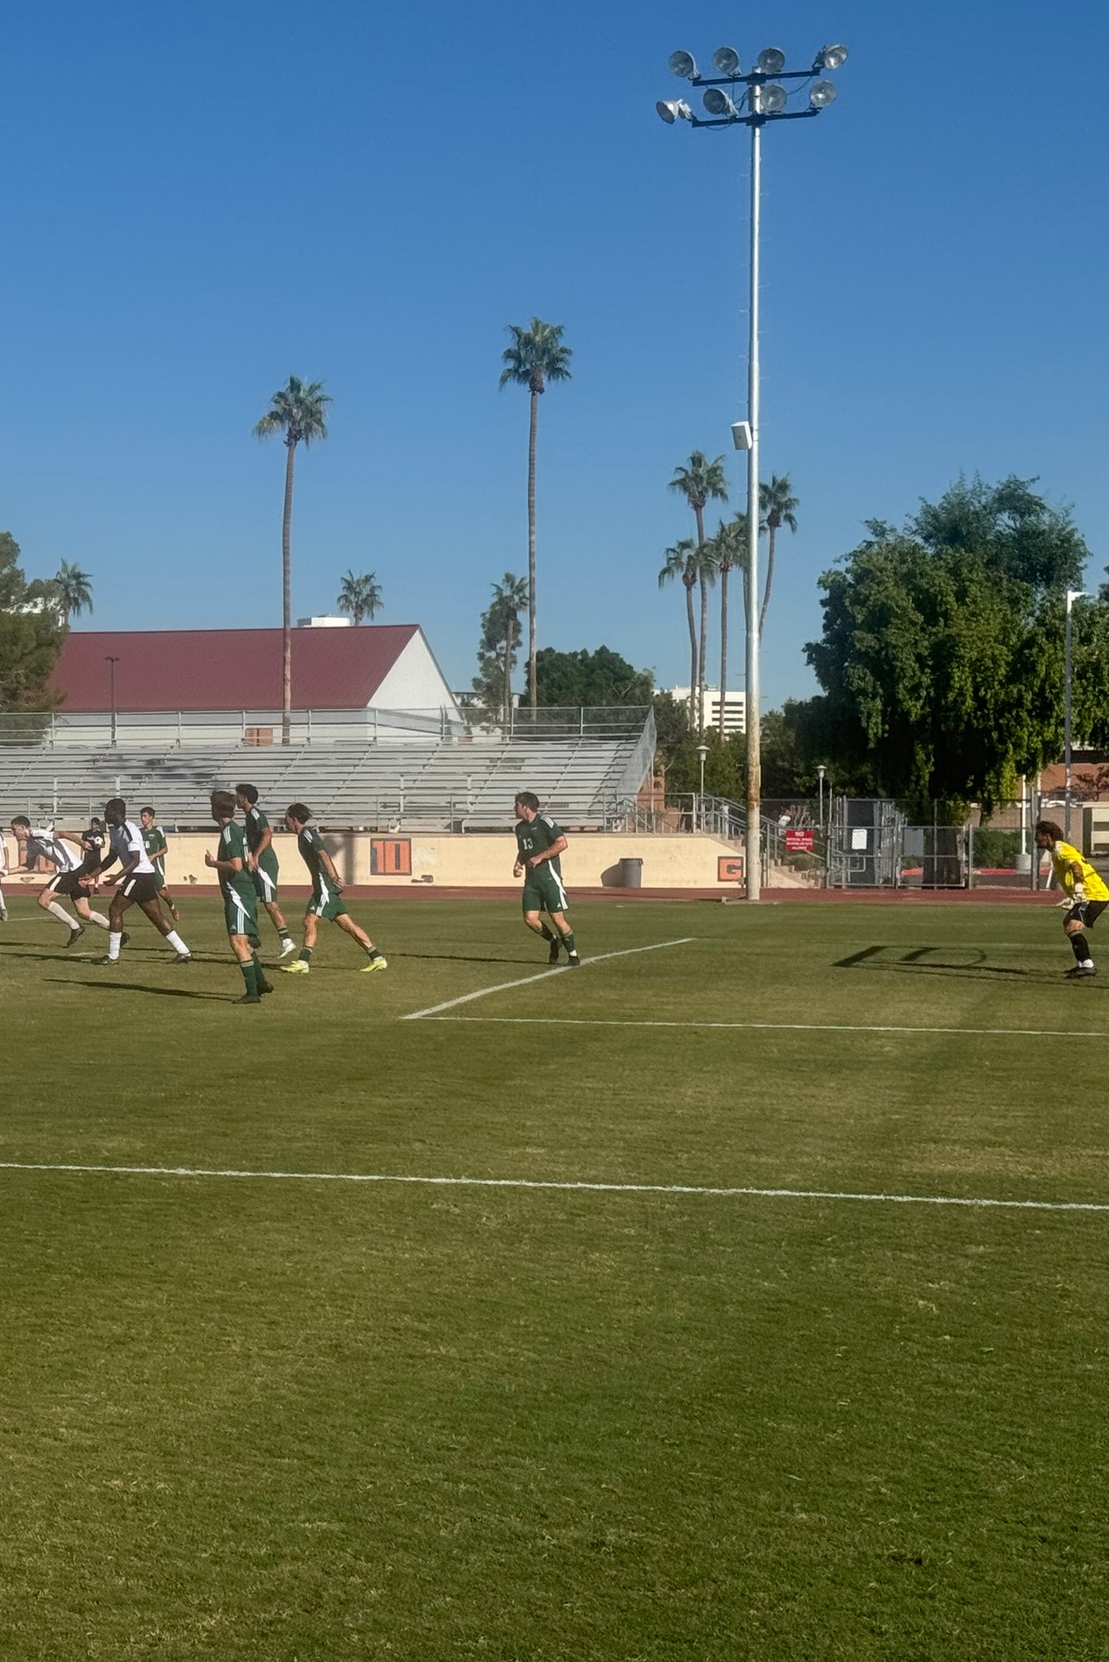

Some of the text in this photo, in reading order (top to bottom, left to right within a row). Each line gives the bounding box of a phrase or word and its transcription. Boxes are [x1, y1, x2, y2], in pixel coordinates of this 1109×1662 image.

[523, 838, 534, 850] 13
[371, 840, 411, 874] 10
[719, 858, 743, 881] G
